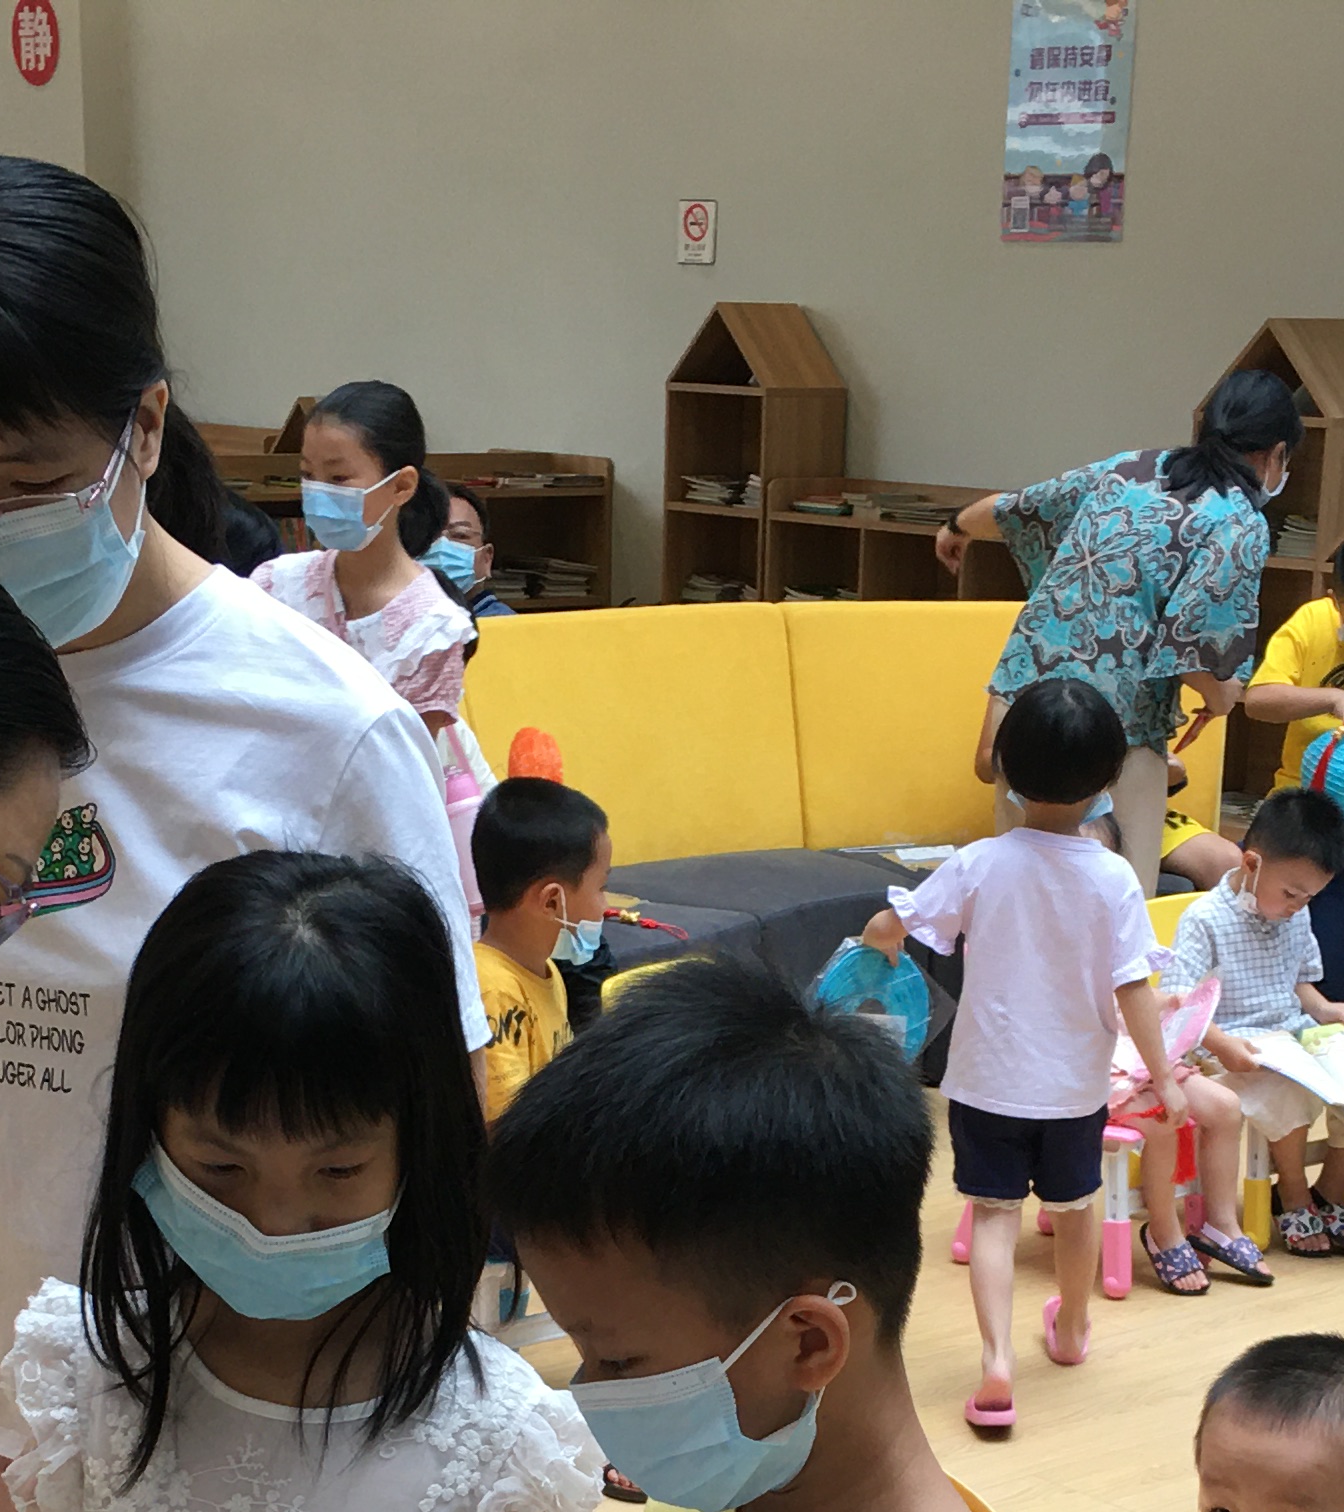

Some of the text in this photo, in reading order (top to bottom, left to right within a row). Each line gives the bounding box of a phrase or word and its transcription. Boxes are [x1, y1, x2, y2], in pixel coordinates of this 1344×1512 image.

[18, 6, 53, 71] 静
[21, 986, 36, 1010] A
[35, 987, 91, 1017] GHOST
[30, 1024, 86, 1055] PHONG
[40, 1067, 72, 1094] ALL
